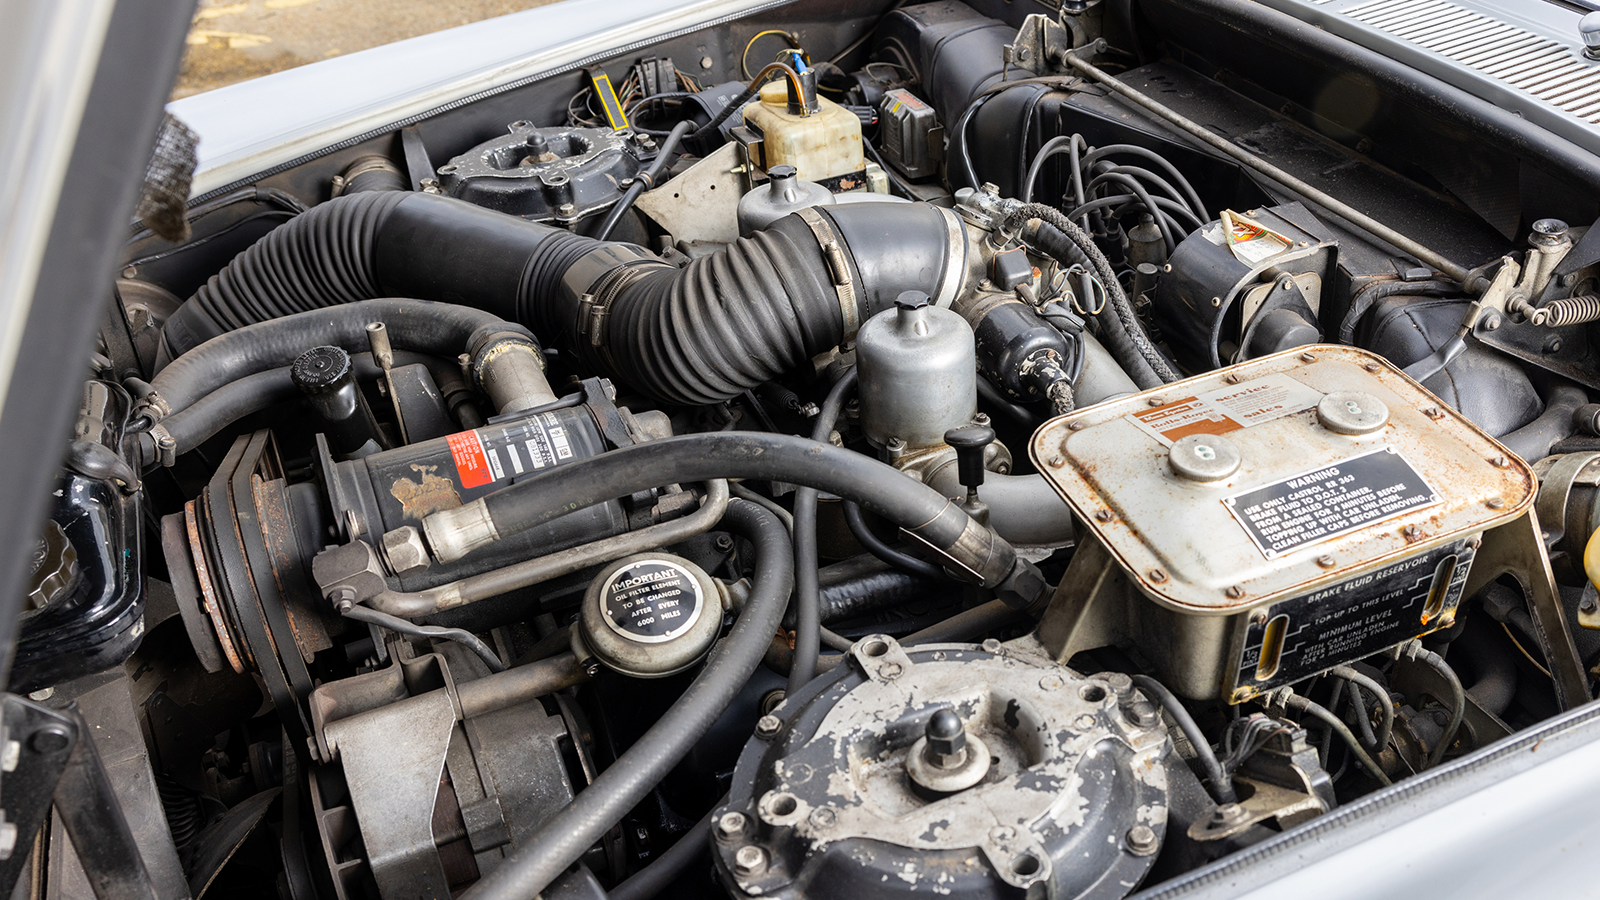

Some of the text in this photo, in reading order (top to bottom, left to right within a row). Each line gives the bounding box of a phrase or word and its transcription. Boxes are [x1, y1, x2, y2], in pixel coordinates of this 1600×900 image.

[1215, 385, 1270, 402] service
[1243, 405, 1283, 418] sales
[1286, 467, 1340, 490] WARNING
[1244, 474, 1355, 516] USE ONLY CASTROL RR 363
[1249, 508, 1278, 522] BRAKE
[1277, 500, 1301, 513] FLUID
[1301, 497, 1314, 505] TO
[1314, 489, 1339, 501] D.O.T.
[1255, 515, 1282, 529] FROM
[1291, 502, 1322, 517] SEALED
[1323, 486, 1373, 506] CONTAINER.
[1260, 524, 1281, 536] RUN
[1281, 514, 1313, 529] ENGINE
[1313, 508, 1333, 519] FOR
[1340, 493, 1377, 510] MINUTES
[1376, 482, 1407, 498] BEFORE
[1265, 493, 1403, 543] TOPPING UP WITH CAR UNLADEN.
[1272, 494, 1429, 550] CLEAN FILLER CAPS BEFORE REMOVING.
[612, 569, 676, 592] IMPORTANT
[615, 579, 681, 602] OIL FILTER ELEMENT
[1307, 555, 1429, 604] BRAKE FLUID RESERVOIR
[622, 589, 681, 610] TO BE CHANGED
[631, 599, 680, 618] AFTER EVERY
[1315, 589, 1404, 625] TOP UP TO THIS LEVEL
[637, 609, 681, 627] 6000 MILES
[1318, 609, 1392, 641] MINIMUM LEVEL
[1302, 620, 1400, 661] AFTER RUNNING ENGINE
[1304, 621, 1385, 653] WITH CAR UNLADEN
[1300, 656, 1317, 667] FOR
[1328, 640, 1362, 657] MINUTES
